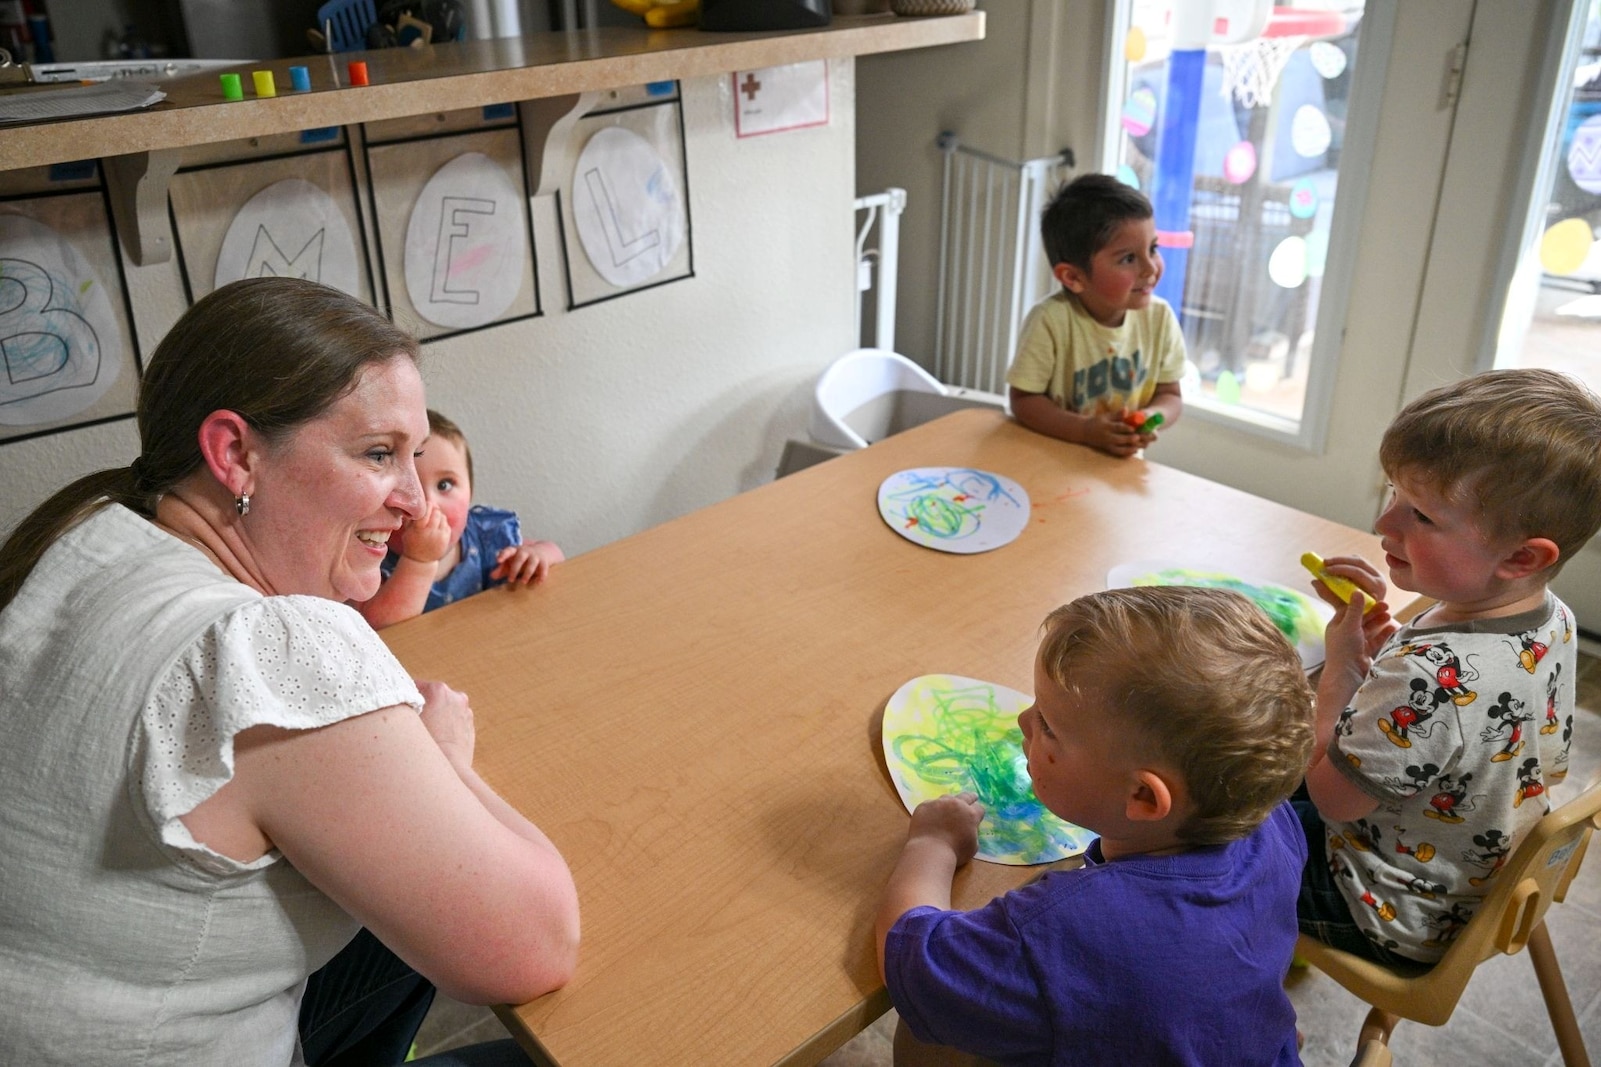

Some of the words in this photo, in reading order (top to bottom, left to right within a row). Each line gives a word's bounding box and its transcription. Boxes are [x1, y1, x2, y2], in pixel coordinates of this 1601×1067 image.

[244, 223, 325, 283] M
[429, 196, 496, 305] E
[584, 167, 660, 268] L
[0, 257, 101, 406] B
